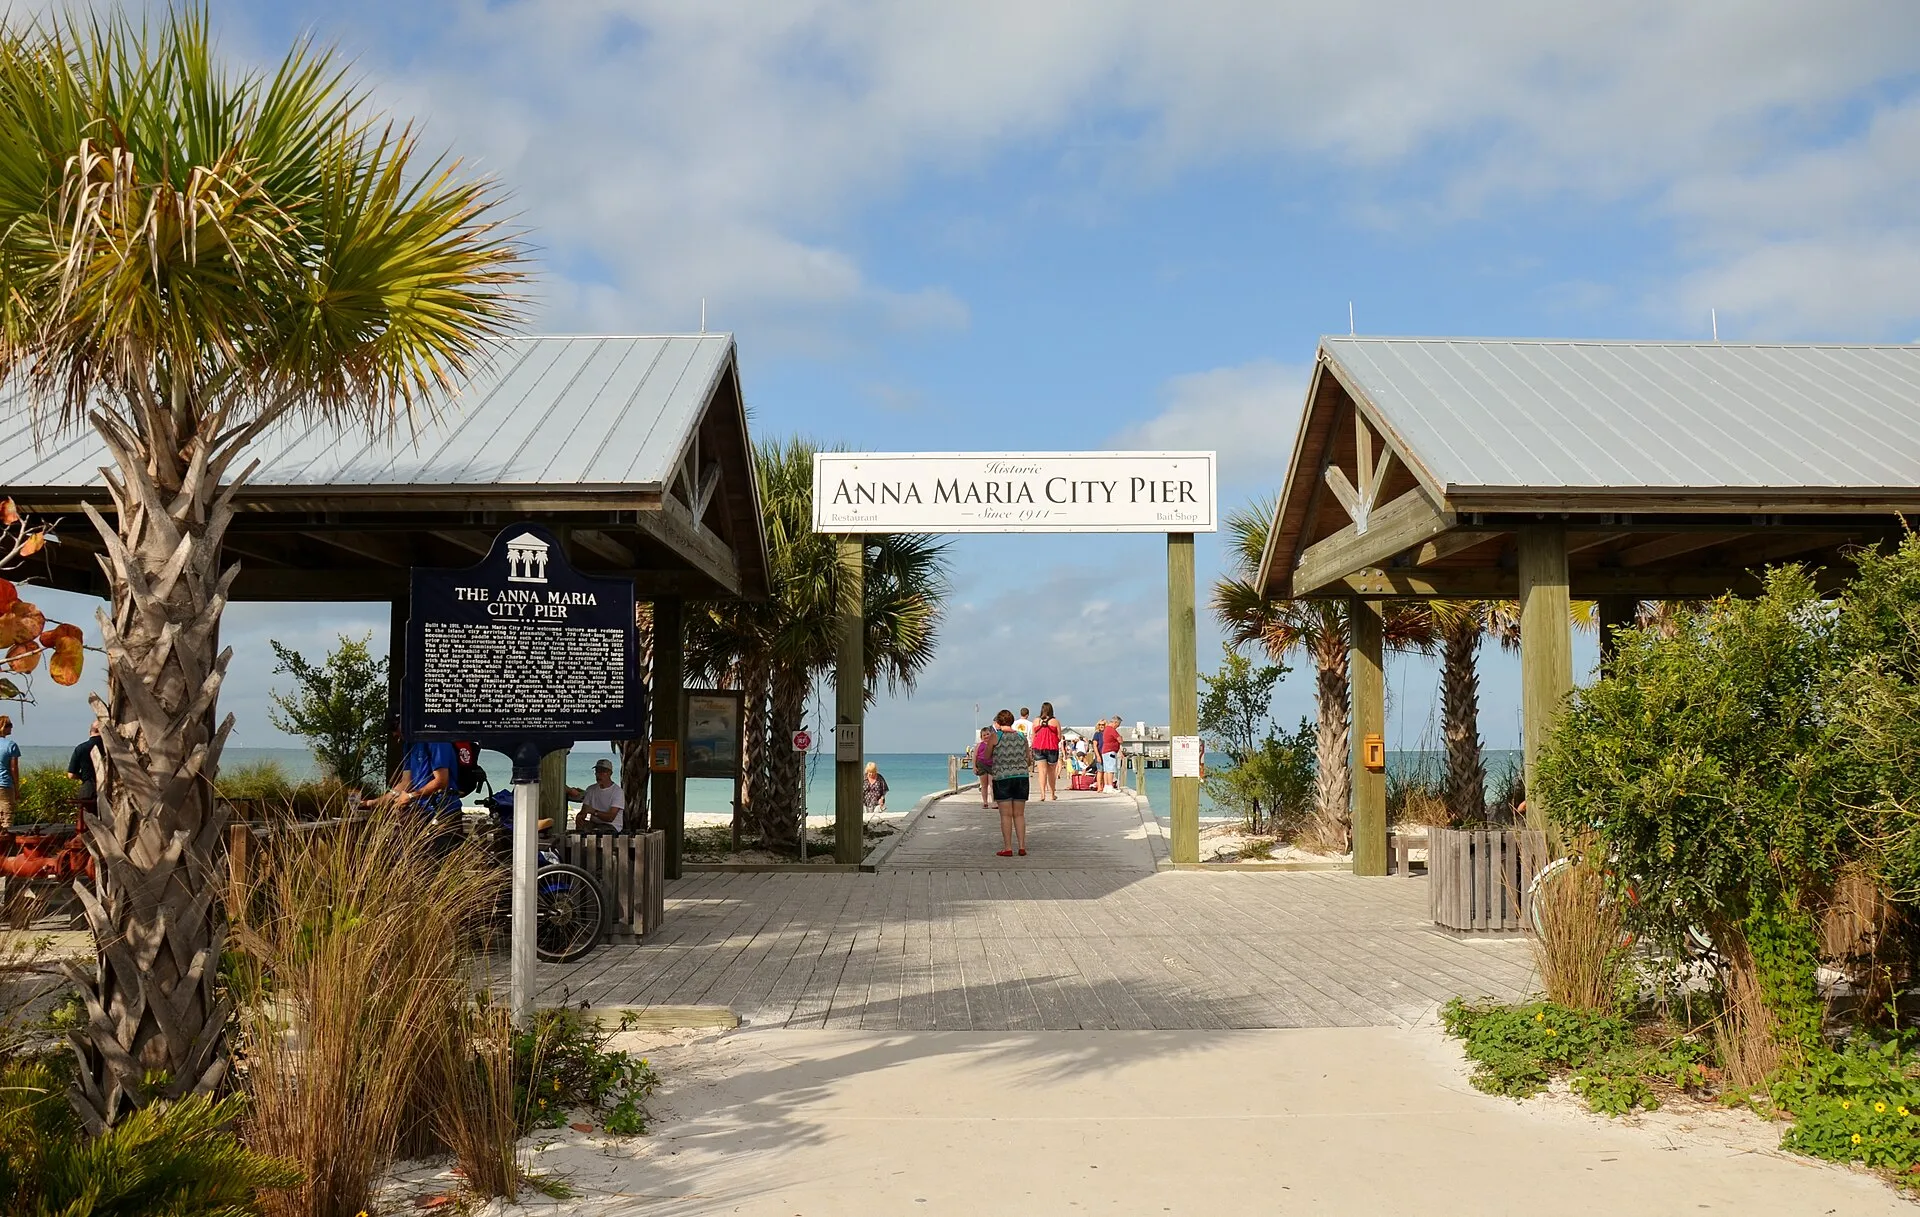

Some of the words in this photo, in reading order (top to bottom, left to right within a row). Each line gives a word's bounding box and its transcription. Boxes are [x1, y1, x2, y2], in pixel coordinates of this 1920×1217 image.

[984, 461, 1042, 474] Historic
[831, 478, 922, 505] ANNA
[933, 477, 1035, 504] MARIA
[1045, 477, 1119, 504] CITY
[1129, 477, 1198, 503] PIER
[831, 513, 878, 522] Restaurant
[978, 507, 1012, 519] Since
[1018, 509, 1050, 521] 1911
[1156, 512, 1174, 521] Bait
[1175, 512, 1198, 522] Shop
[455, 587, 489, 601] THE
[497, 589, 540, 603] ANNA
[548, 591, 597, 606] MARIA
[487, 602, 526, 617] CITY
[535, 604, 568, 618] PIER
